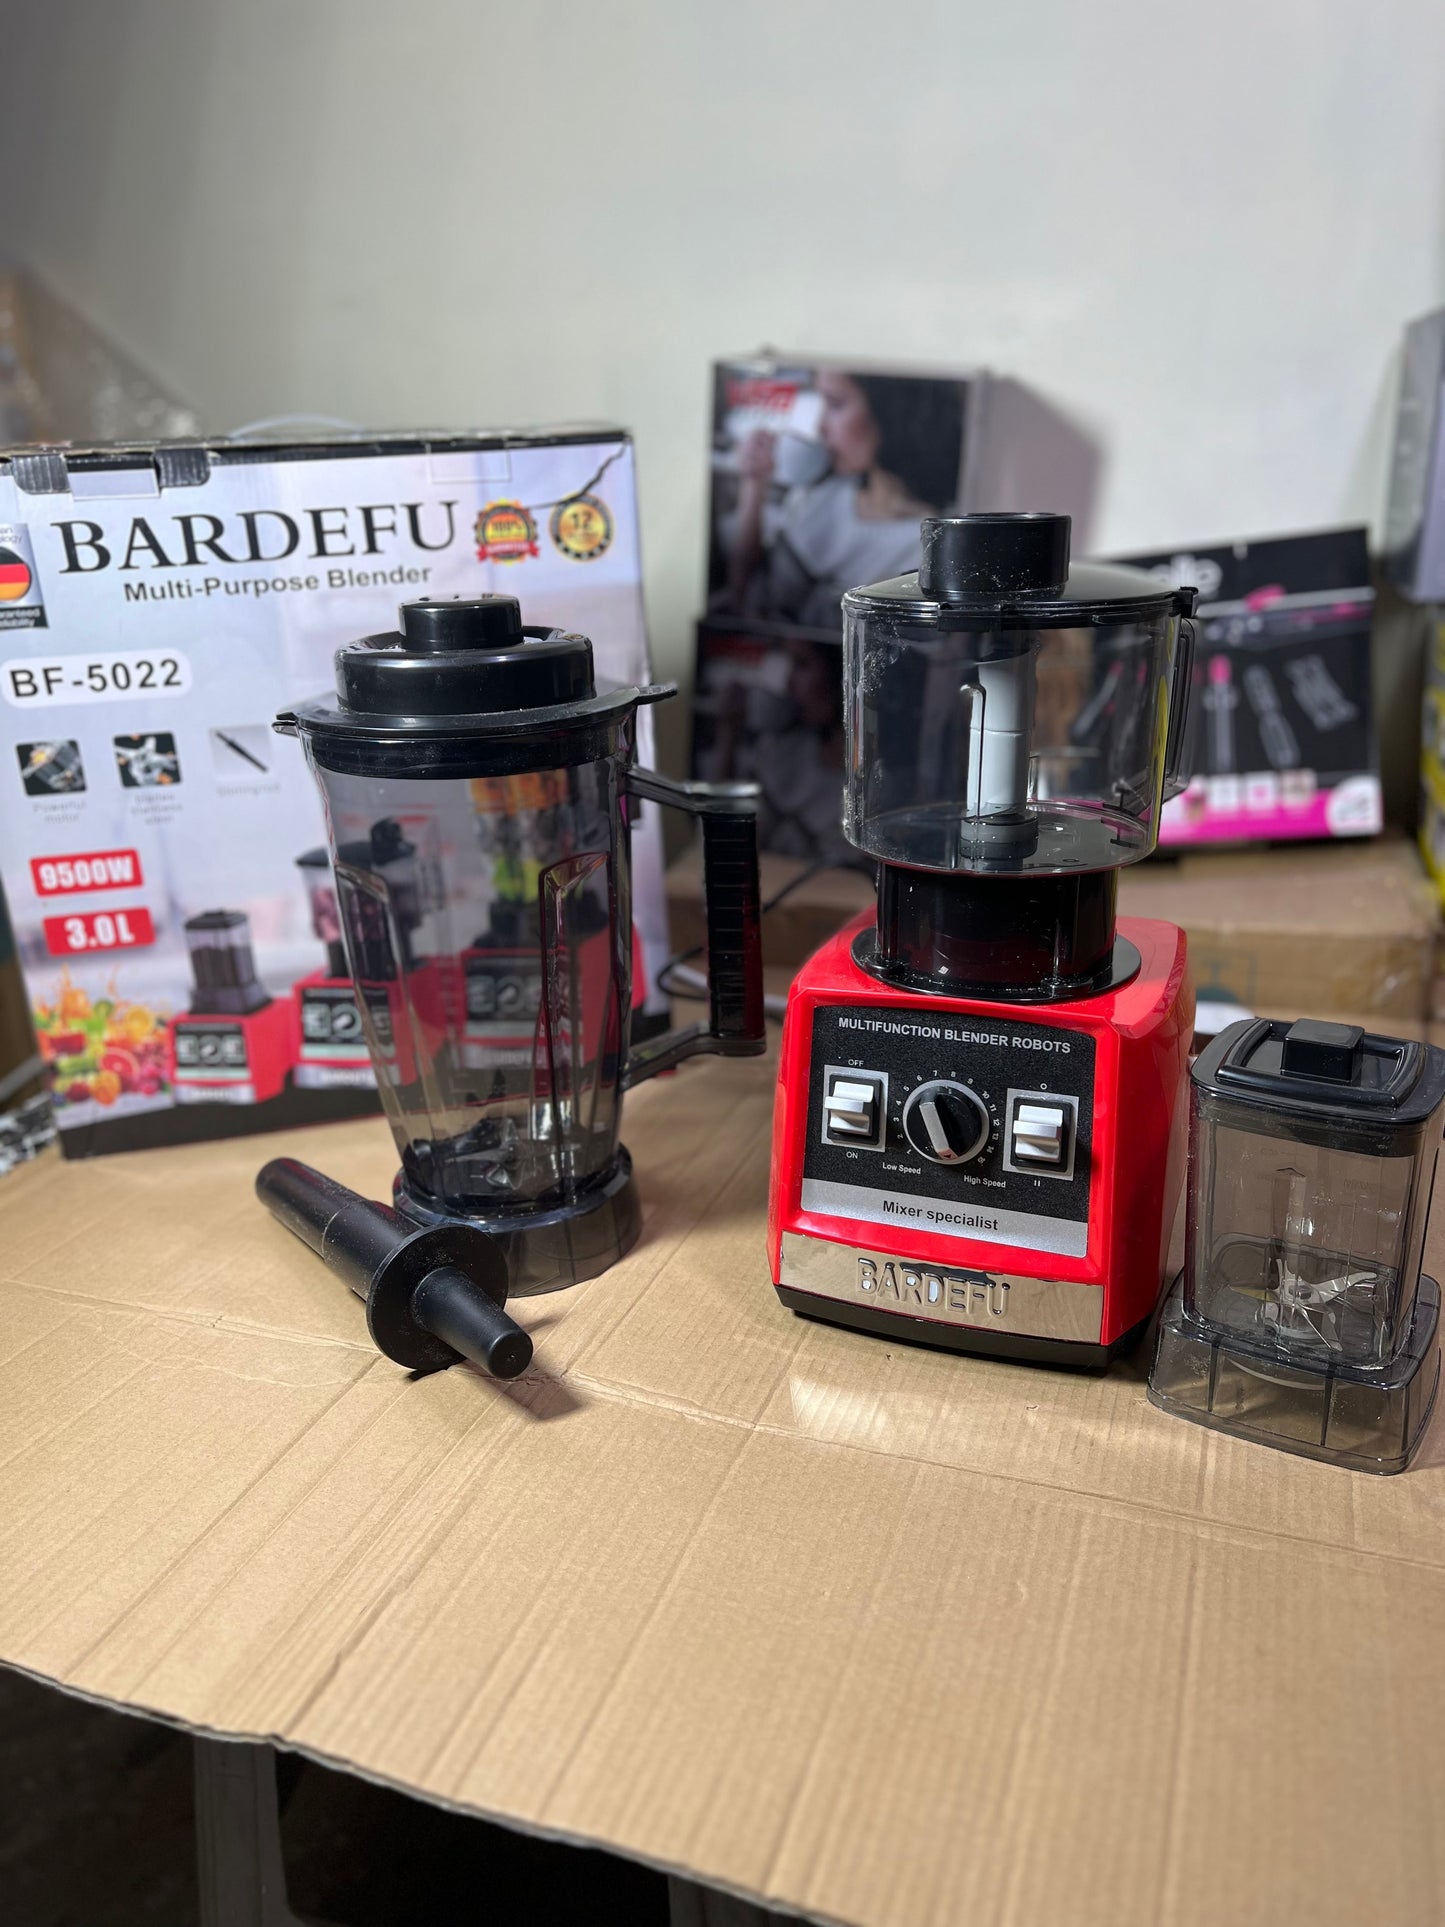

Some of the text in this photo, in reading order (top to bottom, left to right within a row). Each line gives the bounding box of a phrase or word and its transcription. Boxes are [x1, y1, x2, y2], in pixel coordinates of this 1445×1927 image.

[50, 500, 459, 574] BARDEFU
[123, 565, 433, 602] Multi-Purpose Blender
[10, 658, 182, 698] BF-5022
[39, 855, 134, 890] 9500W
[64, 913, 135, 949] 3.0L
[838, 1017, 1071, 1053] MULTIFUNCTION BLENDER ROBOTS
[848, 1058, 864, 1067] OFF
[981, 1090, 990, 1099] 10
[989, 1103, 997, 1112] 11
[993, 1118, 1000, 1126] 12
[846, 1151, 858, 1159] ON
[882, 1162, 921, 1175] Low Speed
[963, 1175, 1006, 1188] High Speed
[883, 1200, 999, 1231] Mixer specialist
[856, 1257, 1011, 1318] BARDEFU
